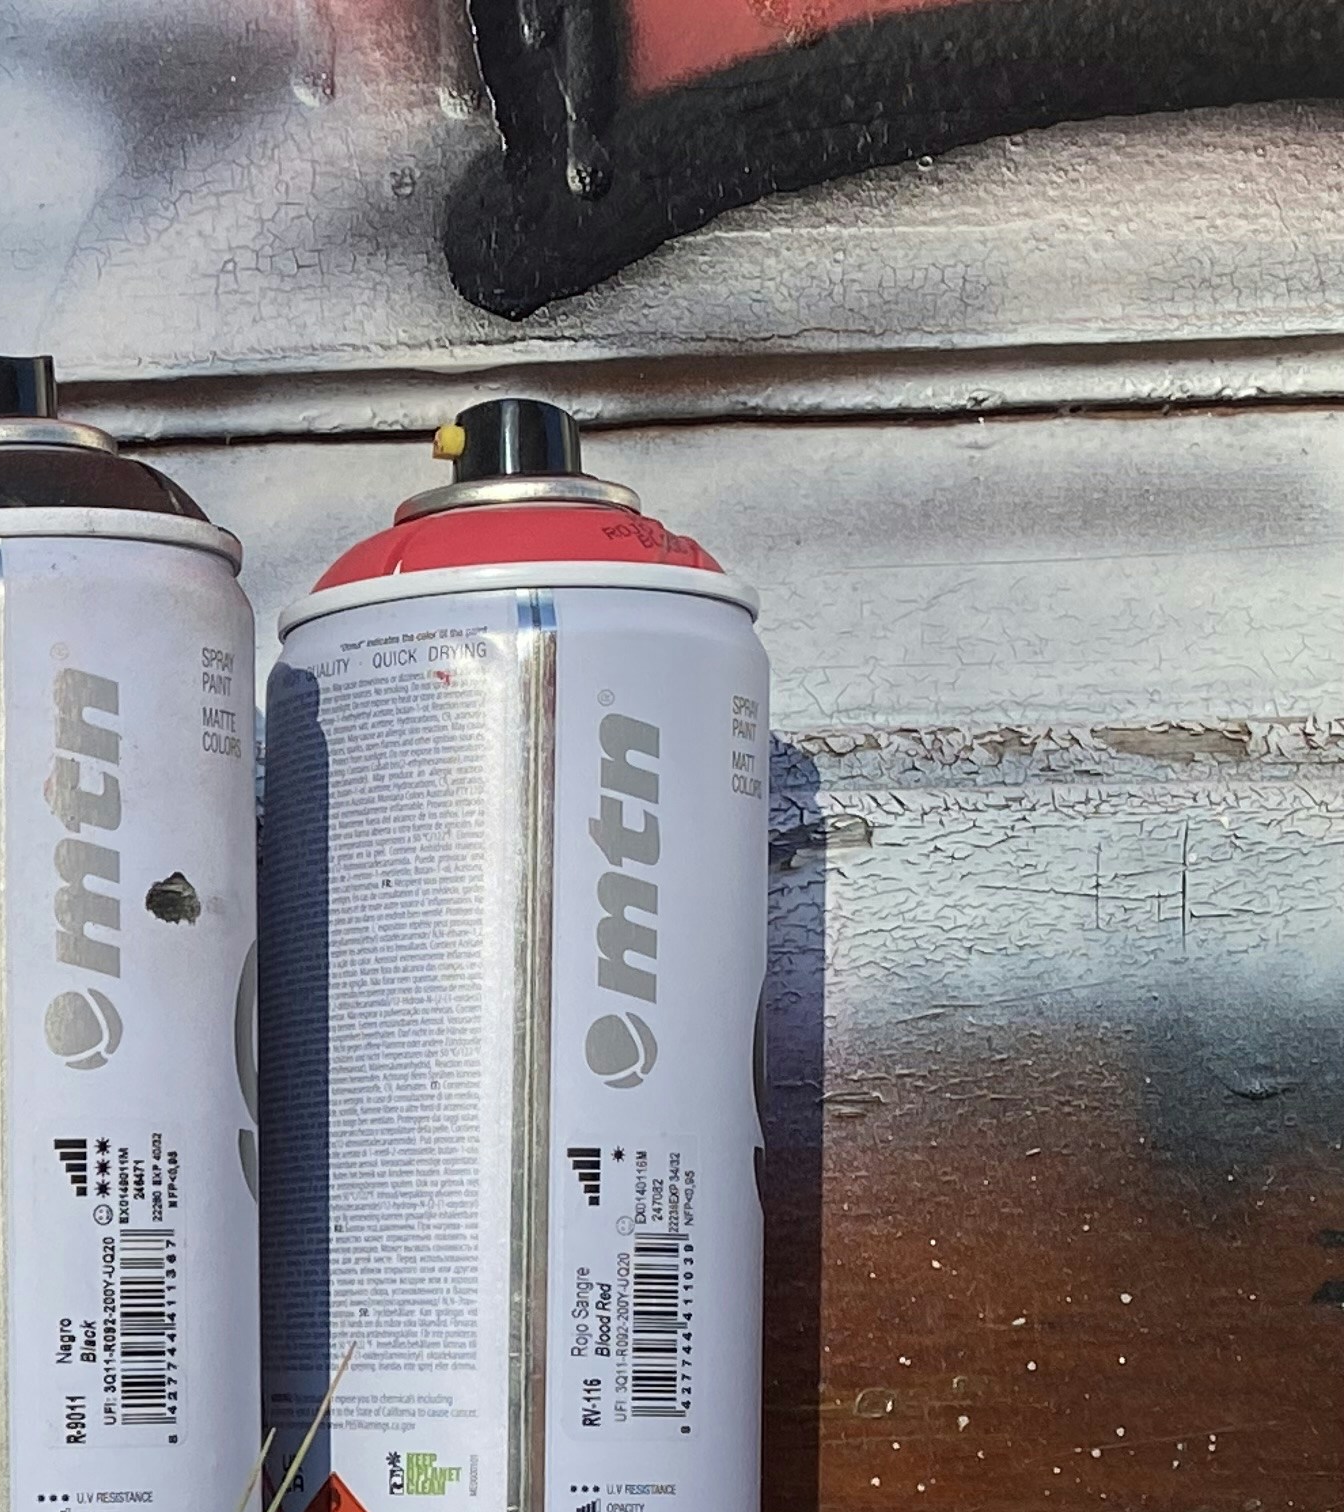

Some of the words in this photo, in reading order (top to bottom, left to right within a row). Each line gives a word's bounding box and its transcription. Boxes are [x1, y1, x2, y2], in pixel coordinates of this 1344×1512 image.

[402, 633, 414, 643] the
[417, 630, 436, 642] color
[450, 627, 463, 638] the
[202, 646, 235, 673] SPRAY
[372, 647, 418, 669] QUICK
[428, 641, 488, 663] DRYING
[202, 671, 232, 697] PAINT
[202, 706, 236, 733] MATTE
[731, 694, 760, 719] SPRAY
[732, 718, 757, 741] PAINT
[202, 730, 242, 759] COLORS
[731, 750, 755, 775] MATT
[731, 775, 762, 800] COLORS
[44, 667, 123, 979] mtn
[588, 711, 661, 1005] mtn
[165, 1238, 178, 1323] 411367
[571, 1266, 594, 1320] Sangre
[680, 1243, 694, 1322] 411039
[595, 1282, 612, 1313] Red
[80, 1319, 98, 1364] Black
[570, 1323, 593, 1358] Rojo
[595, 1314, 612, 1358] Blood
[166, 1332, 178, 1416] 427744
[680, 1331, 693, 1411] 427744
[380, 1393, 416, 1404] chemicals
[417, 1393, 454, 1406] including
[381, 1407, 416, 1418] California
[581, 1377, 602, 1428] RV-116
[64, 1394, 88, 1445] R-9011
[406, 1452, 437, 1467] KEEP
[96, 1491, 154, 1503] RESISTANCE
[624, 1483, 677, 1495] RESISTANCE
